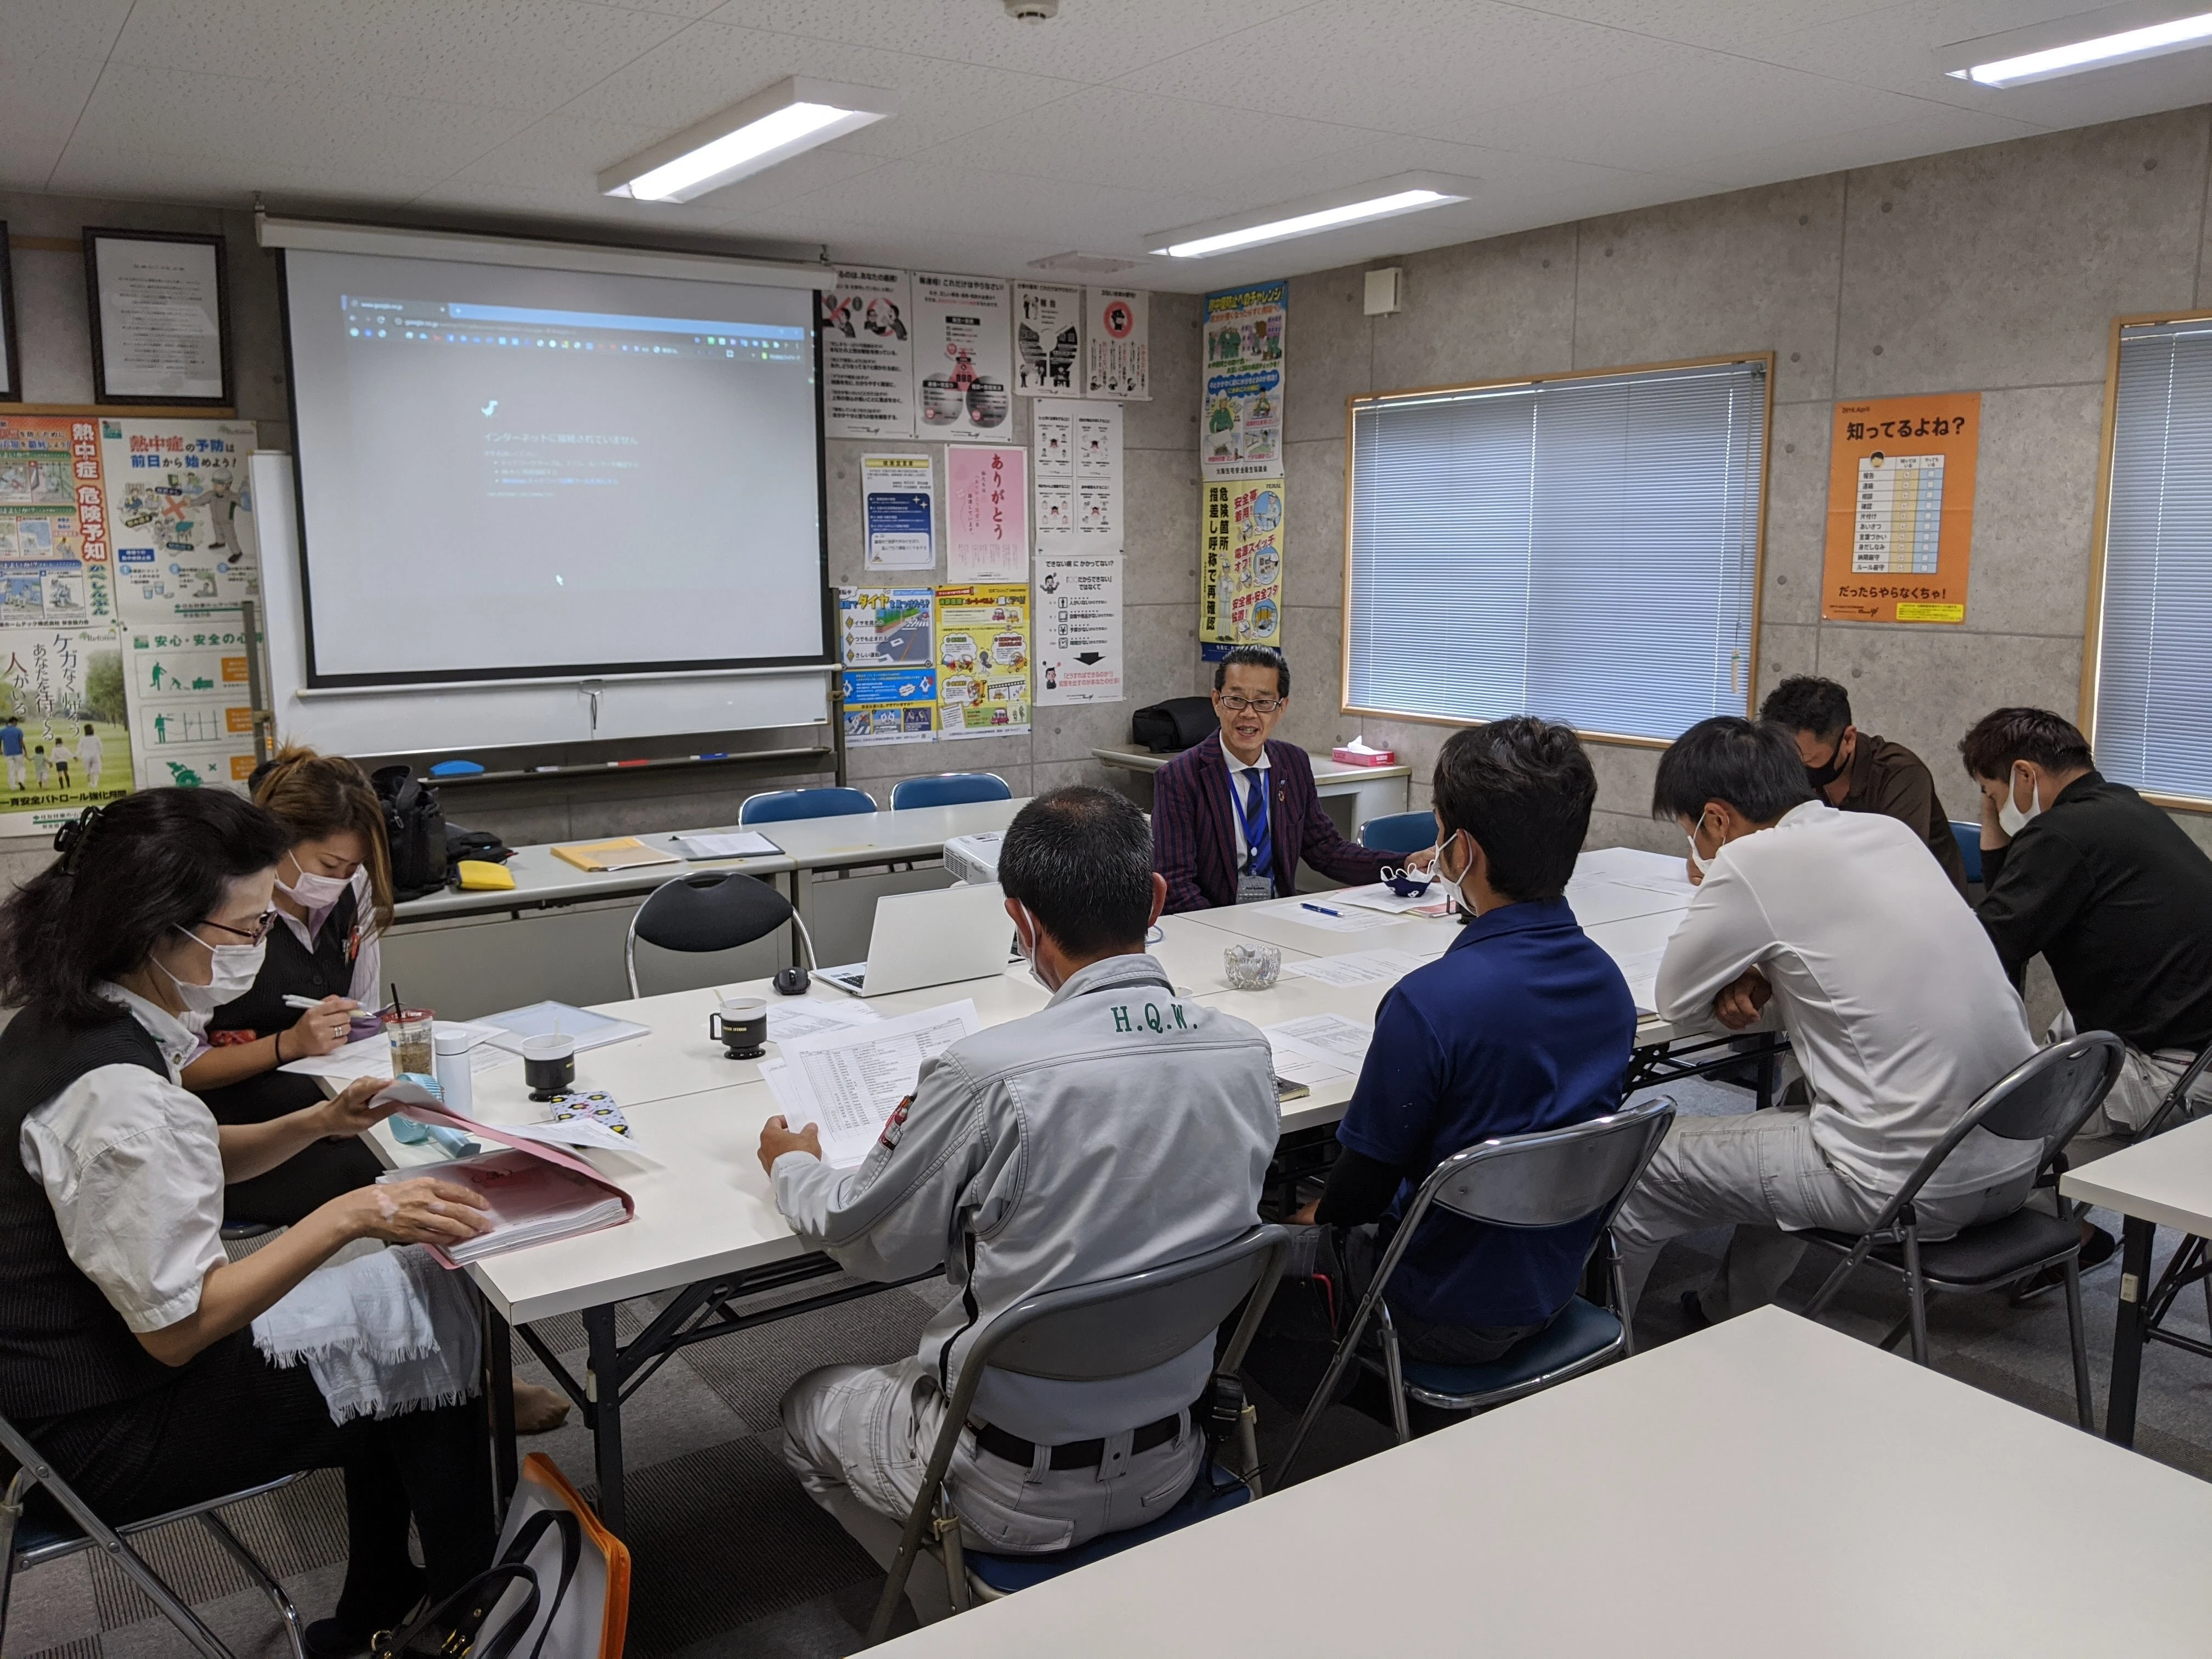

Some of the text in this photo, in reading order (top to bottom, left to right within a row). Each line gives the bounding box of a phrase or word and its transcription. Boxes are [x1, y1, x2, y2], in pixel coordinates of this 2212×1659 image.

[129, 435, 235, 452] 熱中症の予防は
[1847, 416, 1965, 440] 知ってるよね?
[991, 453, 1005, 540] ありがとう
[1219, 487, 1229, 551] 危険箇所
[1206, 487, 1218, 630] 指差し呼称で再確認
[1838, 585, 1946, 599] だったらやらなくちゃ!
[4, 651, 29, 715] 人がいる
[1110, 1003, 1198, 1034] H.Q.W.
